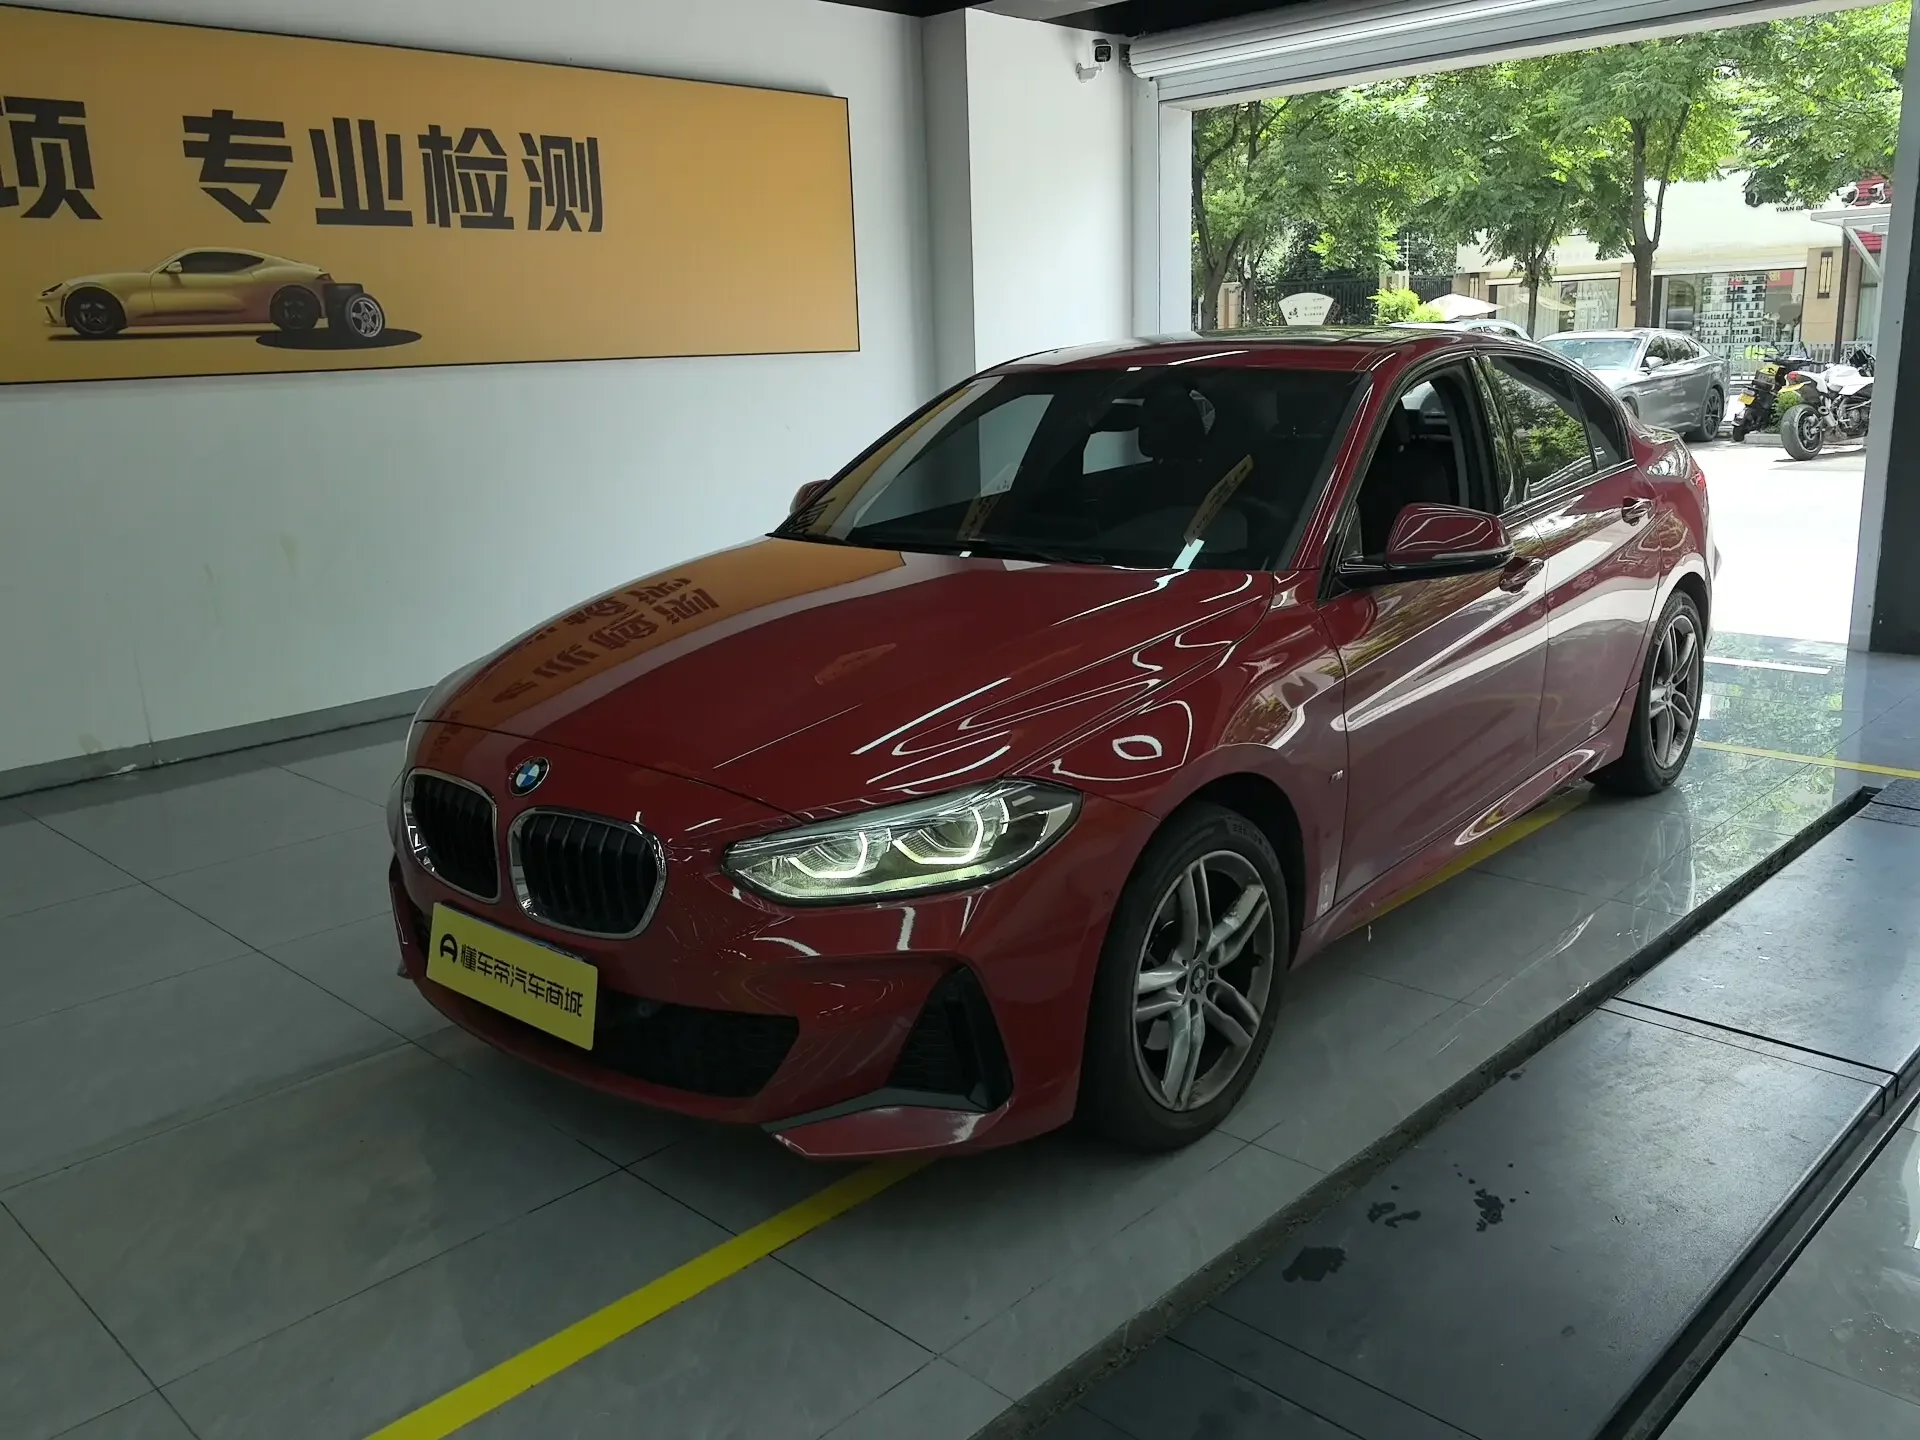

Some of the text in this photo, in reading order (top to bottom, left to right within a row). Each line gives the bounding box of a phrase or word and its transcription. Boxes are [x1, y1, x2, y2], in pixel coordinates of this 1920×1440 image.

[182, 109, 603, 233] 专业检测
[1795, 203, 1824, 211] BEUTY
[461, 943, 584, 1018] 懂车帝汽车商城
